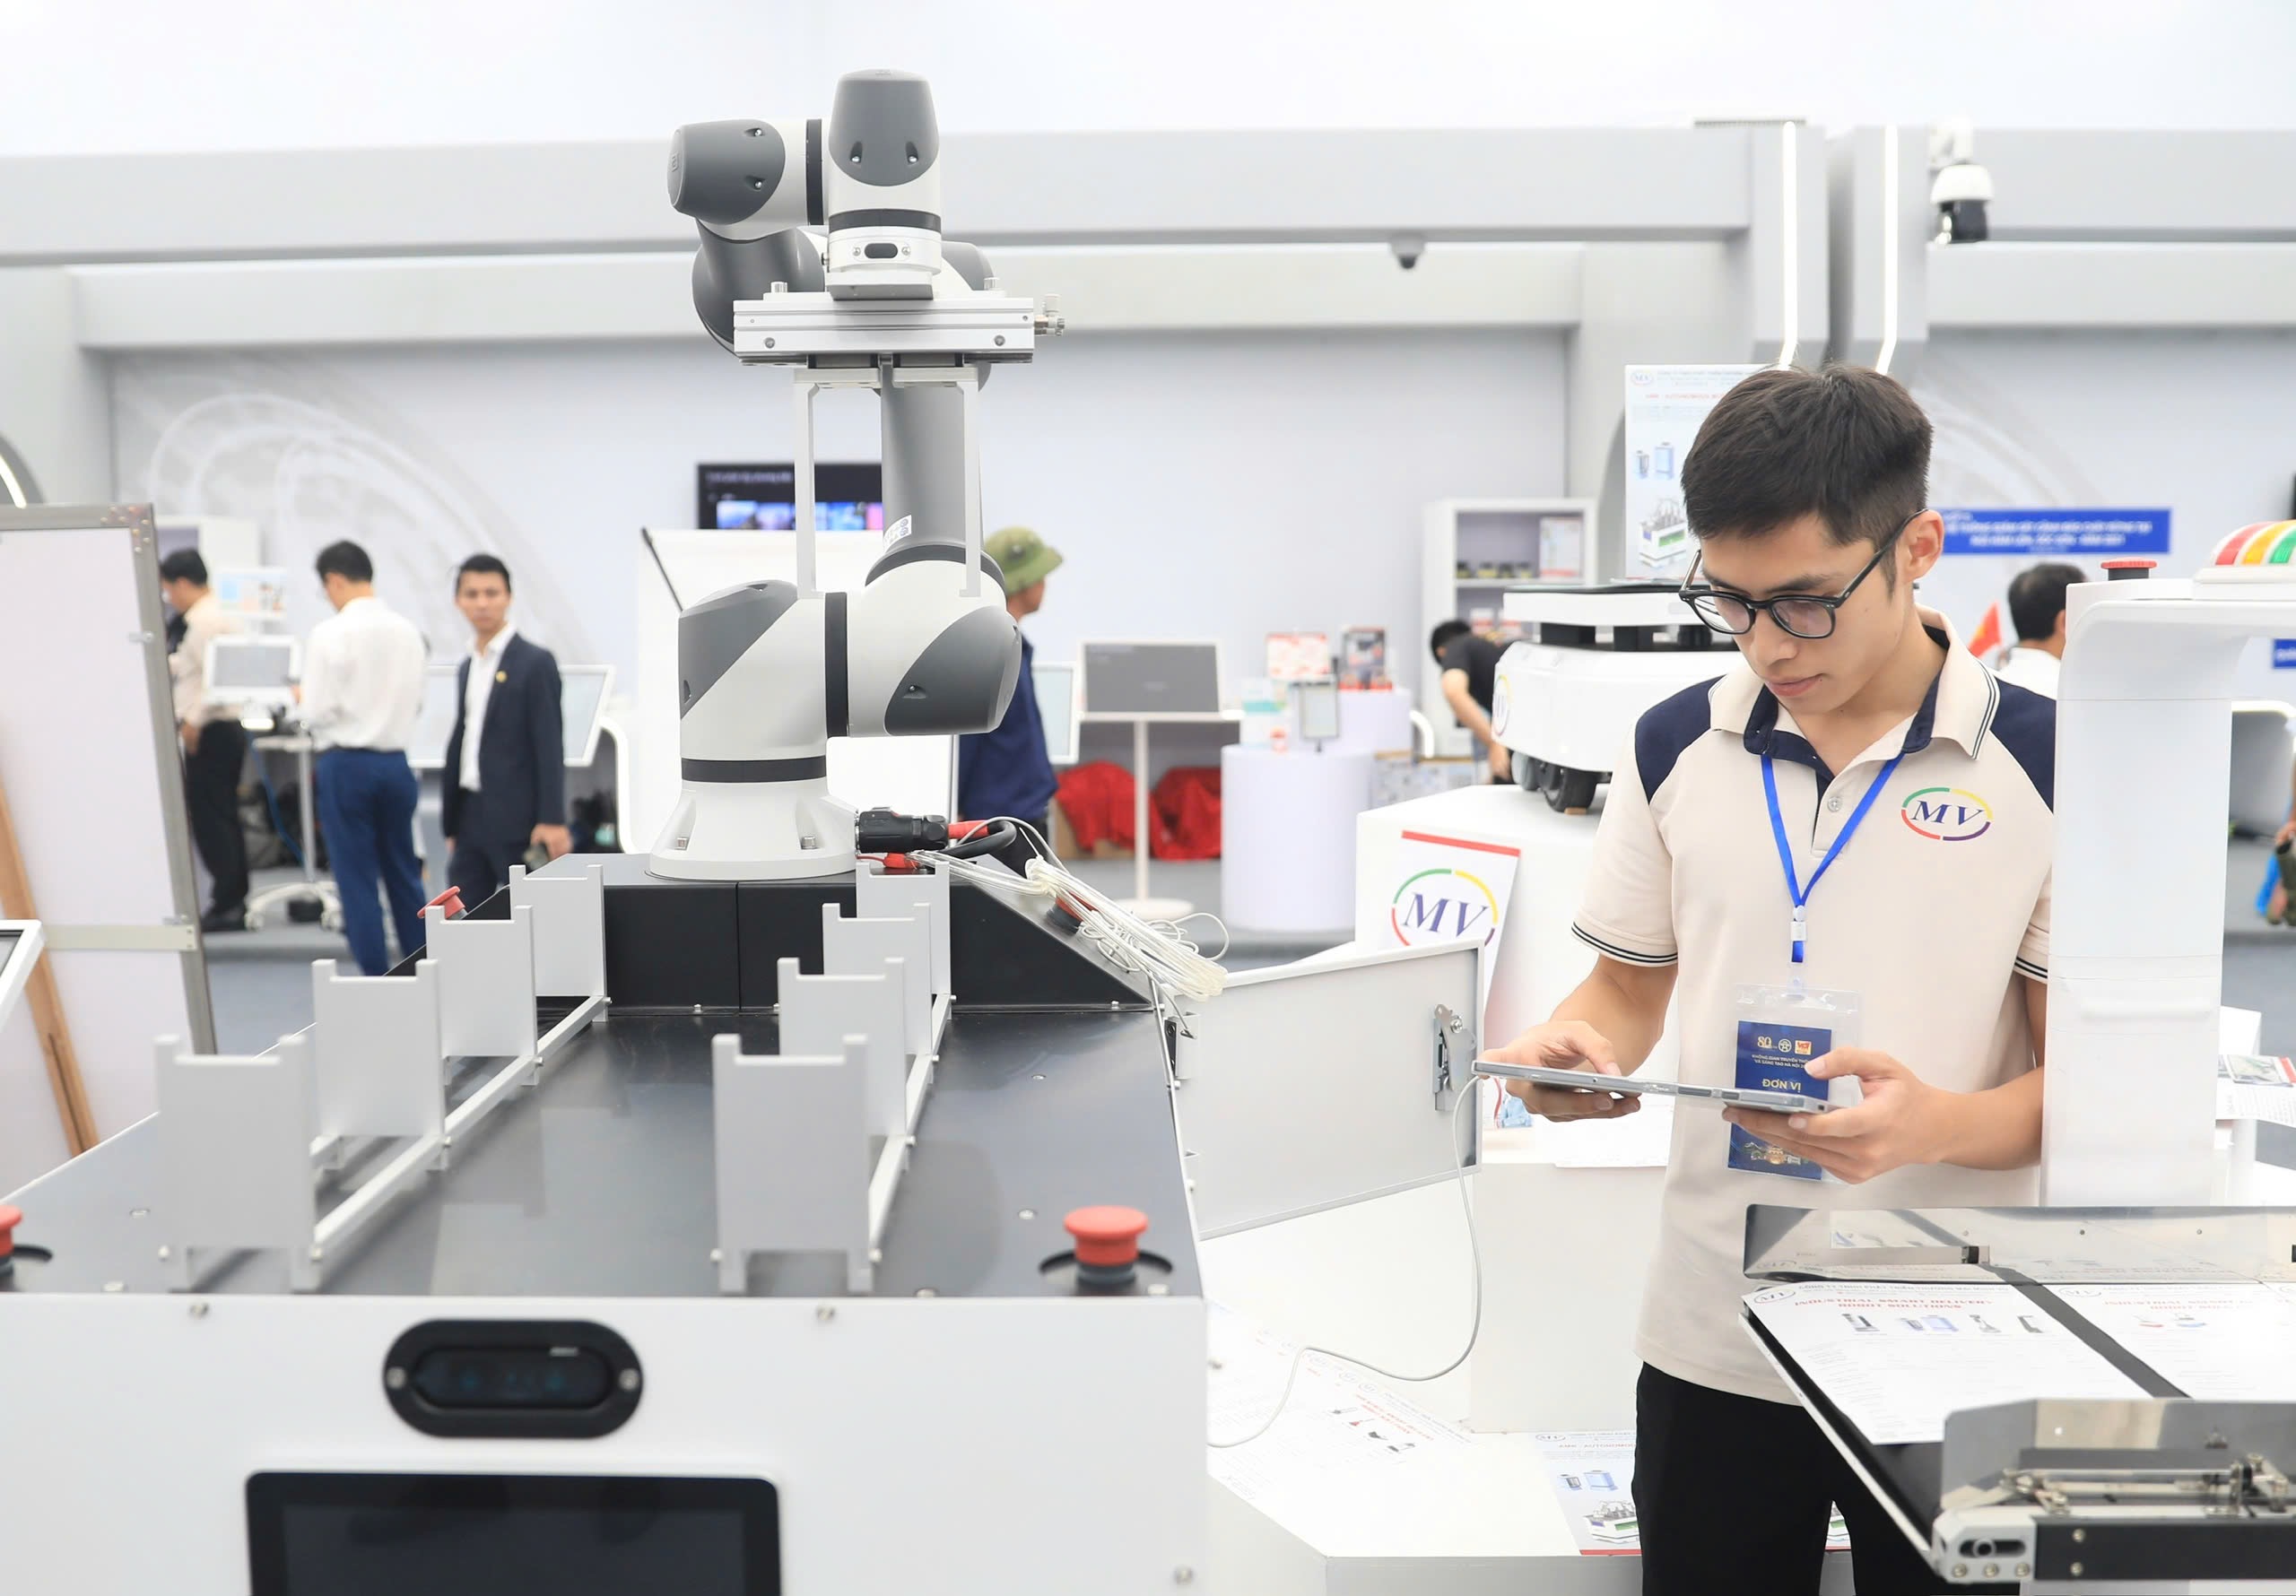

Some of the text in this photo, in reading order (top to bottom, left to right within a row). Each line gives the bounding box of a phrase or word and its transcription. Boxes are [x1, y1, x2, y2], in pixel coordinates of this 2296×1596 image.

[1910, 800, 1984, 826] MV
[1401, 892, 1490, 937] MV
[1762, 1079, 1801, 1093] ĐƠN VỊ
